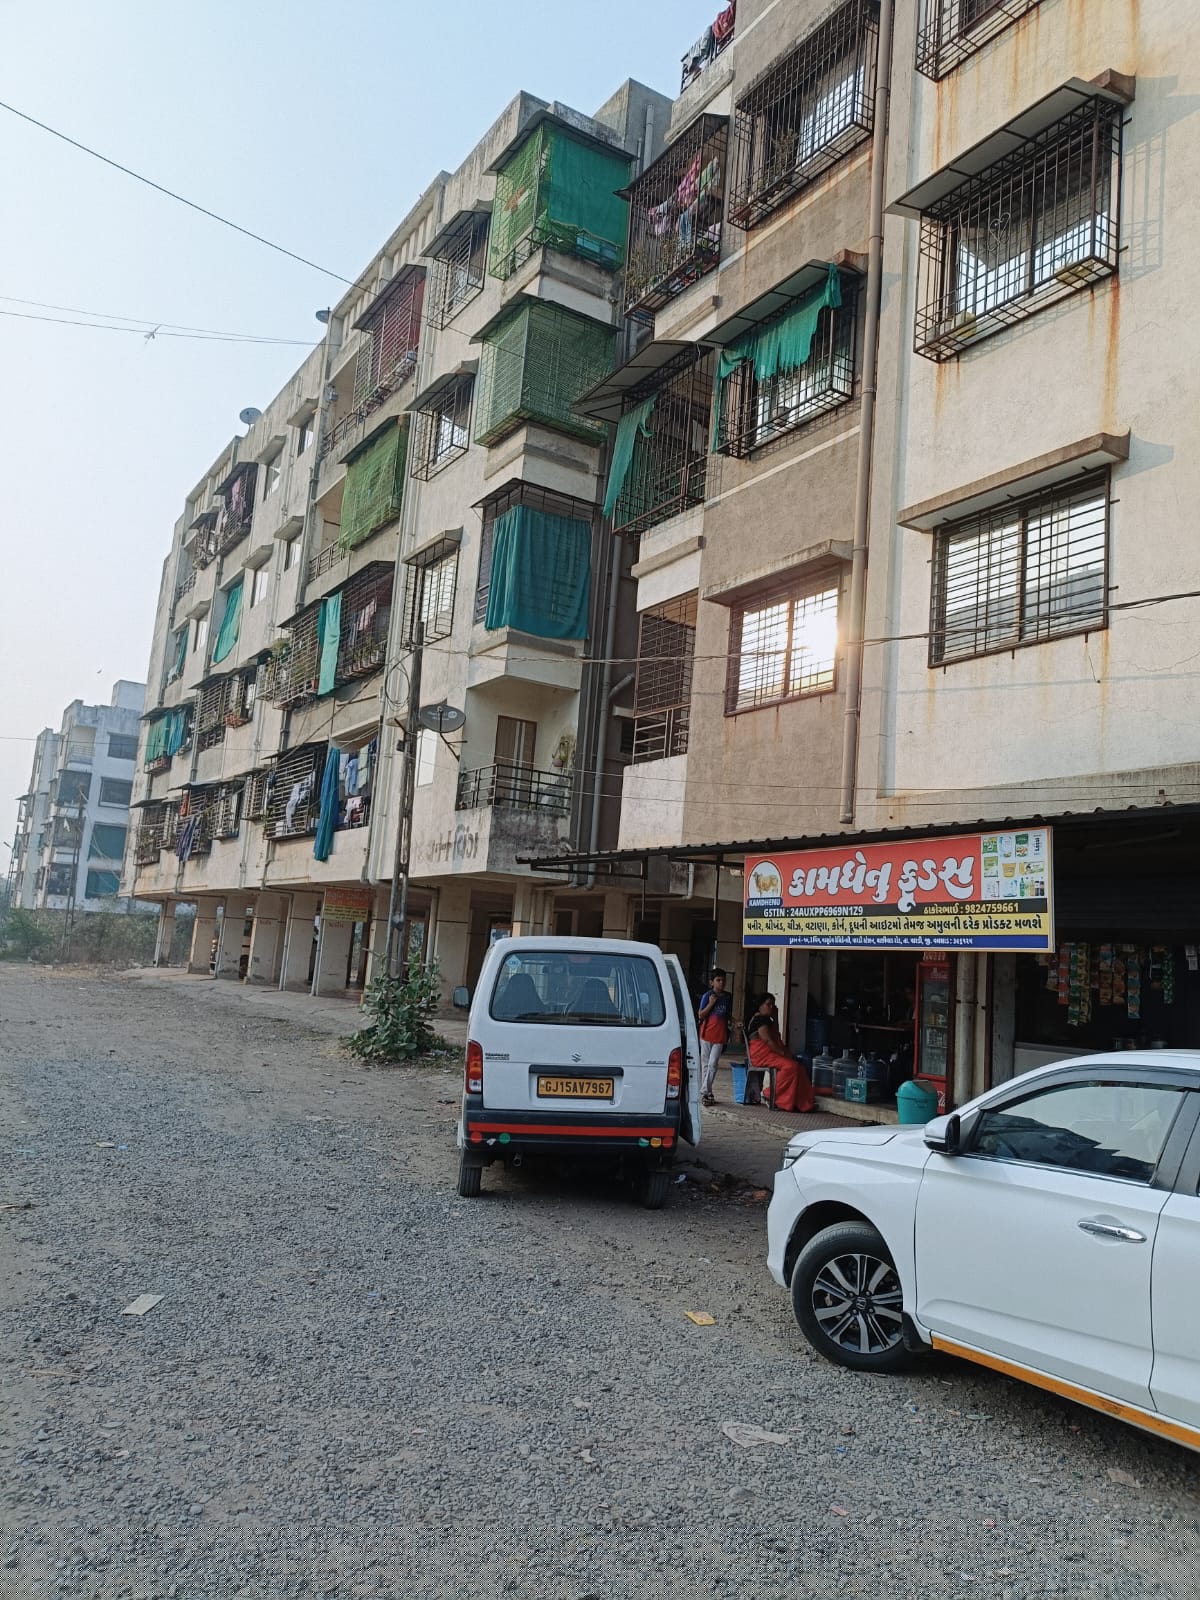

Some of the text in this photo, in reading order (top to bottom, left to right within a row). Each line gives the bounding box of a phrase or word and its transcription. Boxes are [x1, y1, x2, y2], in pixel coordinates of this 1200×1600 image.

[788, 850, 893, 903] કામધેનુ
[749, 898, 781, 907] KAMDHENU
[964, 902, 1019, 914] 9824759661
[763, 908, 785, 917] GSTIN
[790, 905, 864, 917] 24AUXPP6969N1Z9
[903, 917, 925, 930] તેમજ
[926, 916, 961, 934] અમુલની
[962, 915, 980, 930] દરેક
[1014, 914, 1042, 929] મળશે
[545, 1081, 611, 1094] GJ15AV7967
